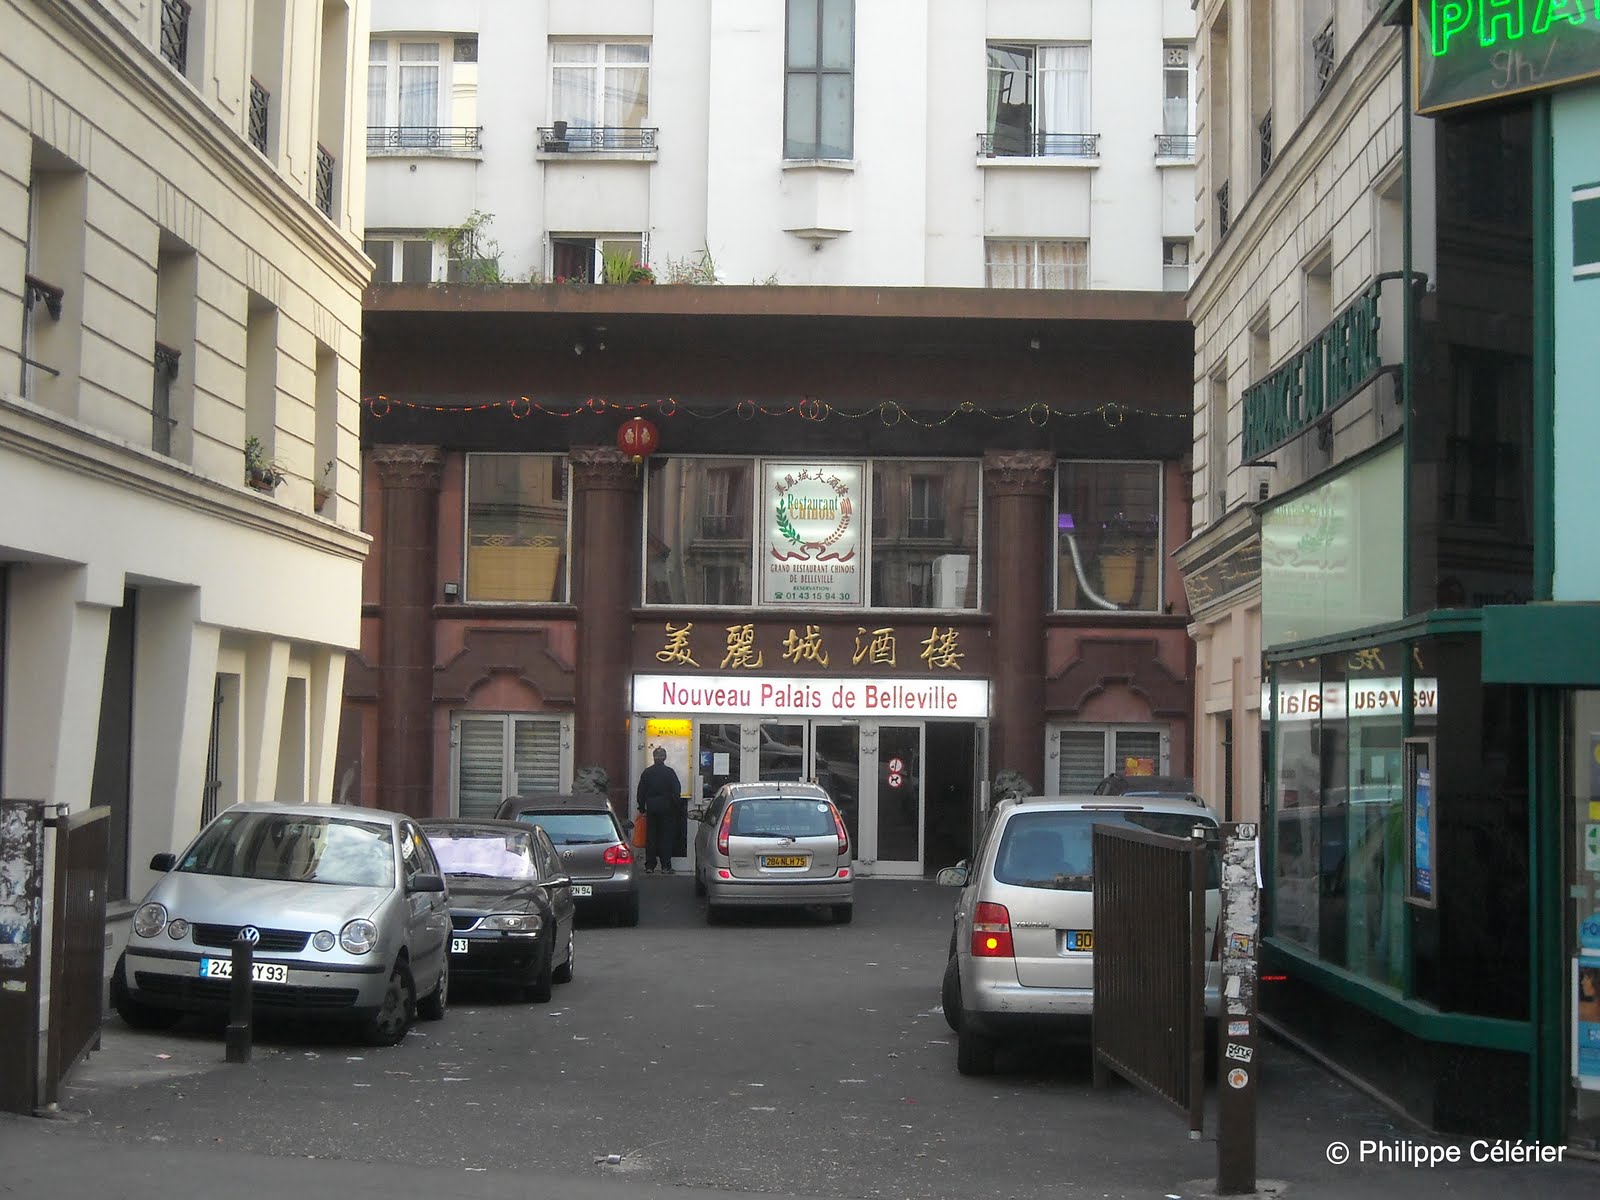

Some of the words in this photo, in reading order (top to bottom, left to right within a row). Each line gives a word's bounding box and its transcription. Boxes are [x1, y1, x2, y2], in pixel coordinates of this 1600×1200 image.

[1431, 0, 1600, 56] PHA
[787, 493, 838, 511] Restaurant
[789, 503, 835, 520] Chinois
[770, 564, 790, 573] GRAND
[793, 564, 828, 573] RESTAURANT
[830, 565, 855, 573] CHINOIS
[789, 575, 797, 583] DE
[801, 575, 833, 583] BELLEVILLE
[798, 592, 809, 600] 43
[812, 592, 822, 600] 15
[825, 592, 836, 600] 94
[839, 592, 850, 600] 30
[656, 622, 965, 671] 美麗城酒樓
[662, 681, 750, 706] Nouveau
[761, 683, 822, 708] Palais
[832, 684, 855, 708] de
[865, 684, 958, 709] Belleville
[581, 886, 590, 894] 94
[453, 940, 467, 951] 93
[266, 966, 284, 981] 93
